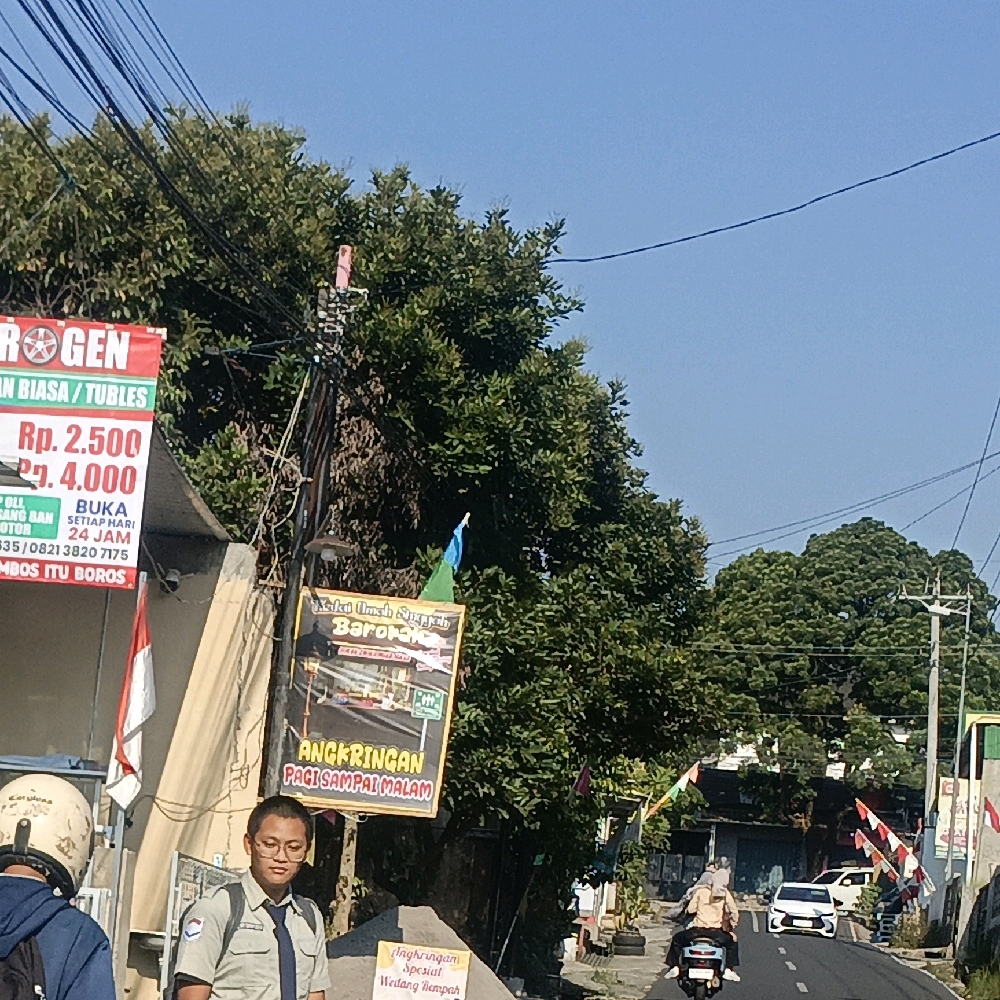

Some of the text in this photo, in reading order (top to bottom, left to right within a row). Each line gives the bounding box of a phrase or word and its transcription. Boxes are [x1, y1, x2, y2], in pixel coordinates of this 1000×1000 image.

[18, 379, 70, 403] BIASA
[72, 382, 82, 403] /
[86, 383, 148, 408] TUBLES
[18, 421, 57, 454] Rp.
[64, 424, 142, 458] 2.500
[60, 462, 137, 494] 4.000
[29, 511, 54, 524] BAN
[75, 499, 128, 517] BUKA
[67, 515, 135, 530] SETIAP HARI
[68, 528, 131, 545] 24 JAM
[30, 542, 60, 556] 0821
[63, 544, 97, 558] 3820
[100, 547, 129, 560] 7175
[44, 564, 69, 580] ITU
[75, 566, 127, 585] BOROS
[298, 739, 425, 774] ANGKRINGAN
[284, 765, 432, 799] PAGI SAMPAI MALAM
